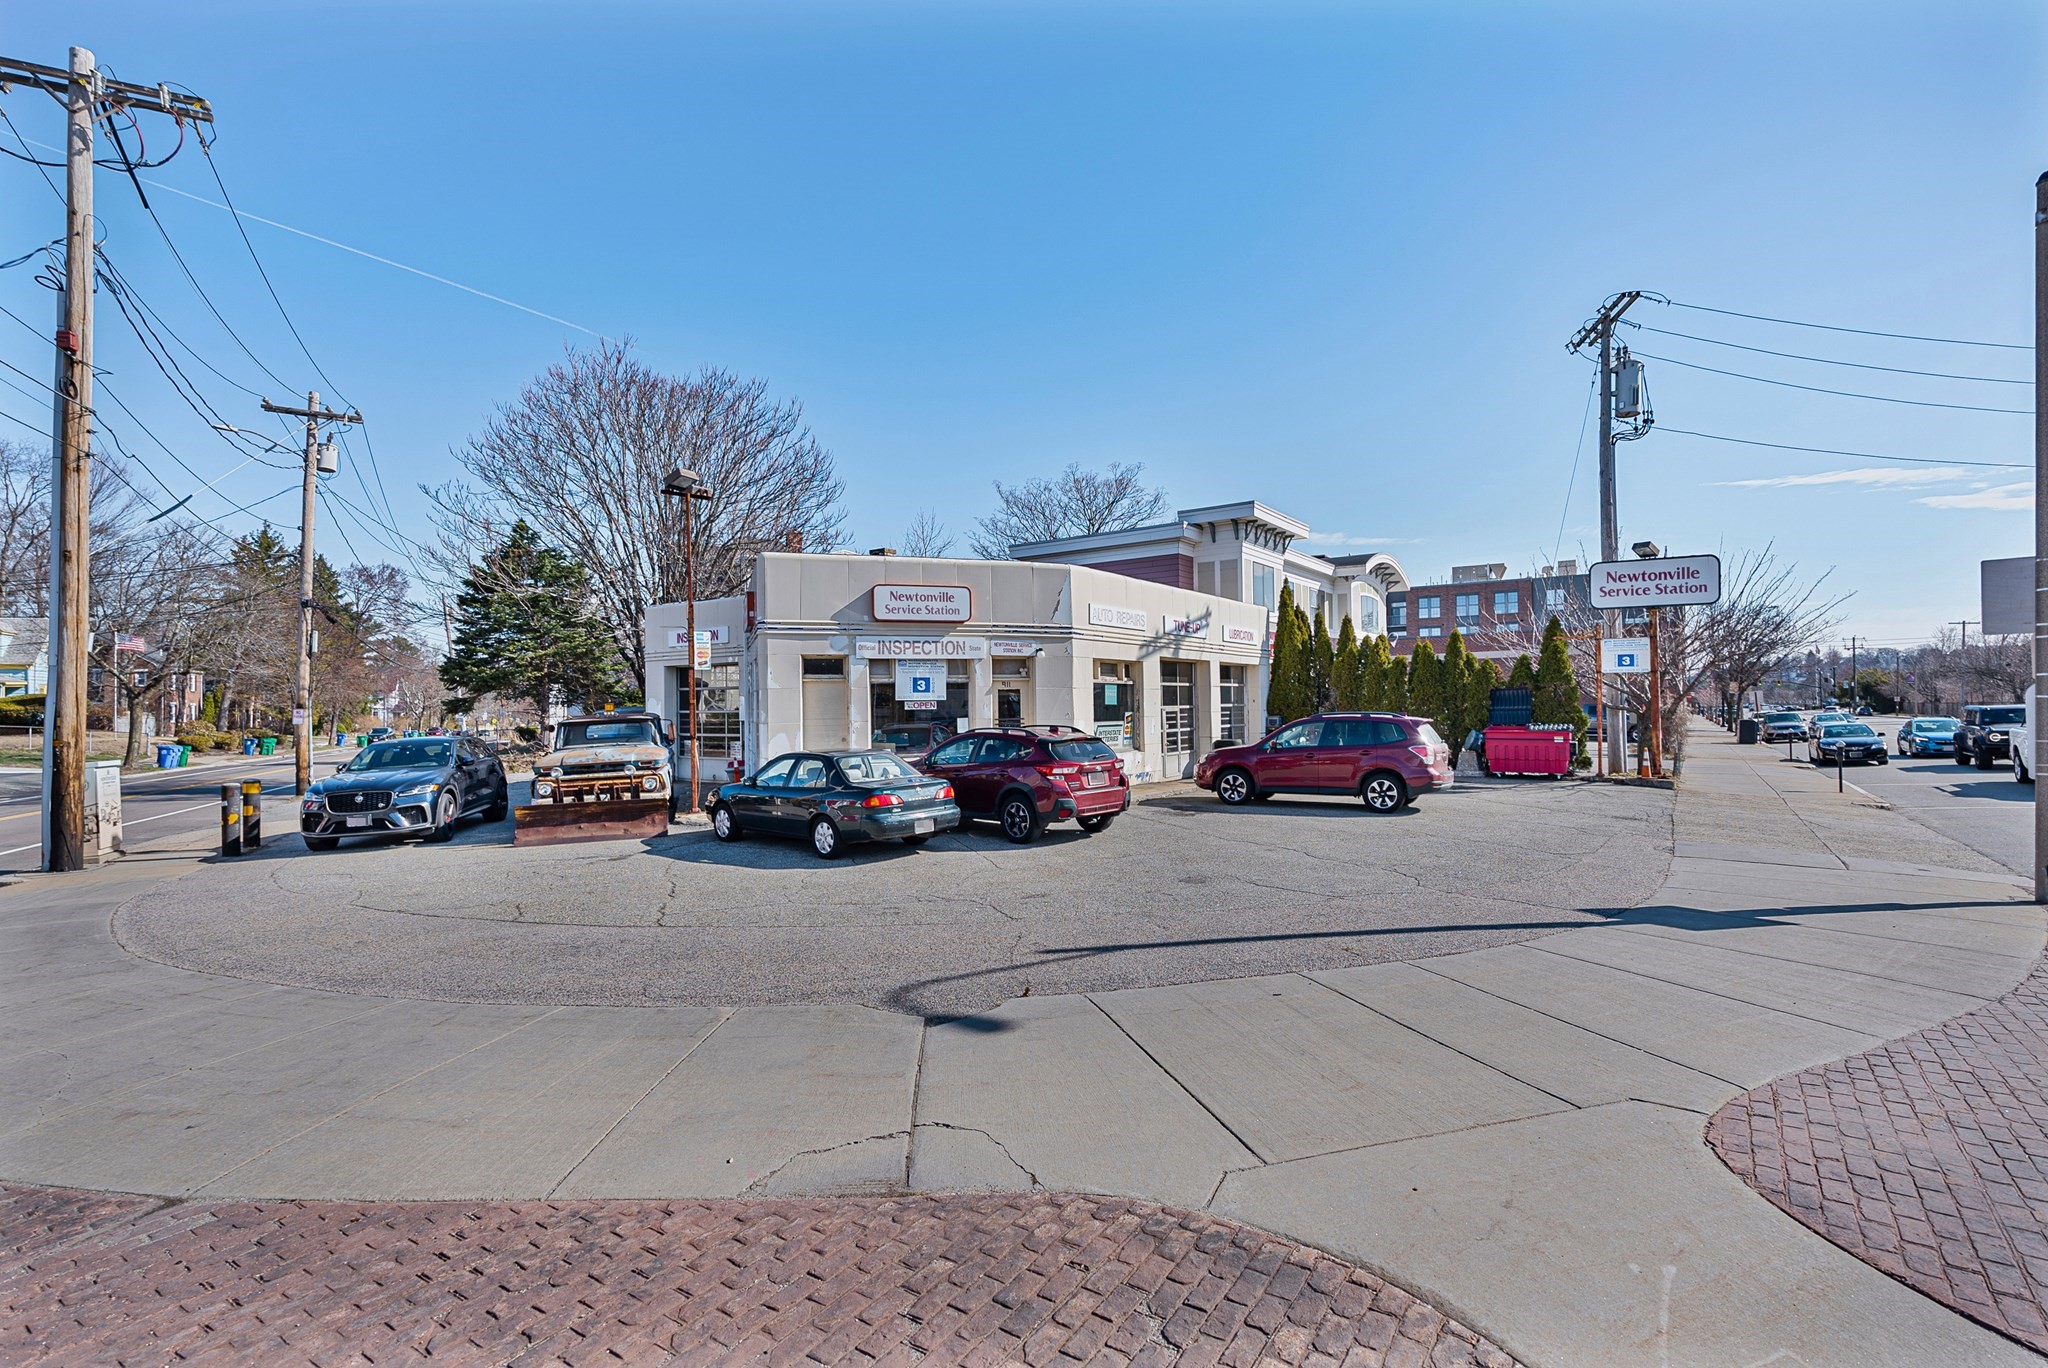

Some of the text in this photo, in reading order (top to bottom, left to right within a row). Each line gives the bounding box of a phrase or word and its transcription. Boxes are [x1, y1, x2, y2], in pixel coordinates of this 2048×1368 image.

[1606, 567, 1700, 584] Newtonville
[889, 590, 955, 603] Newtonville
[1599, 582, 1708, 598] Service Station
[884, 604, 960, 616] Service Station
[1092, 607, 1146, 628] AUTO REPAIRS
[1173, 619, 1201, 635] TUNE-UP
[1228, 628, 1254, 642] LUBRICATION
[877, 640, 967, 656] INSPECTION
[1621, 656, 1631, 666] 3
[916, 679, 926, 691] 3
